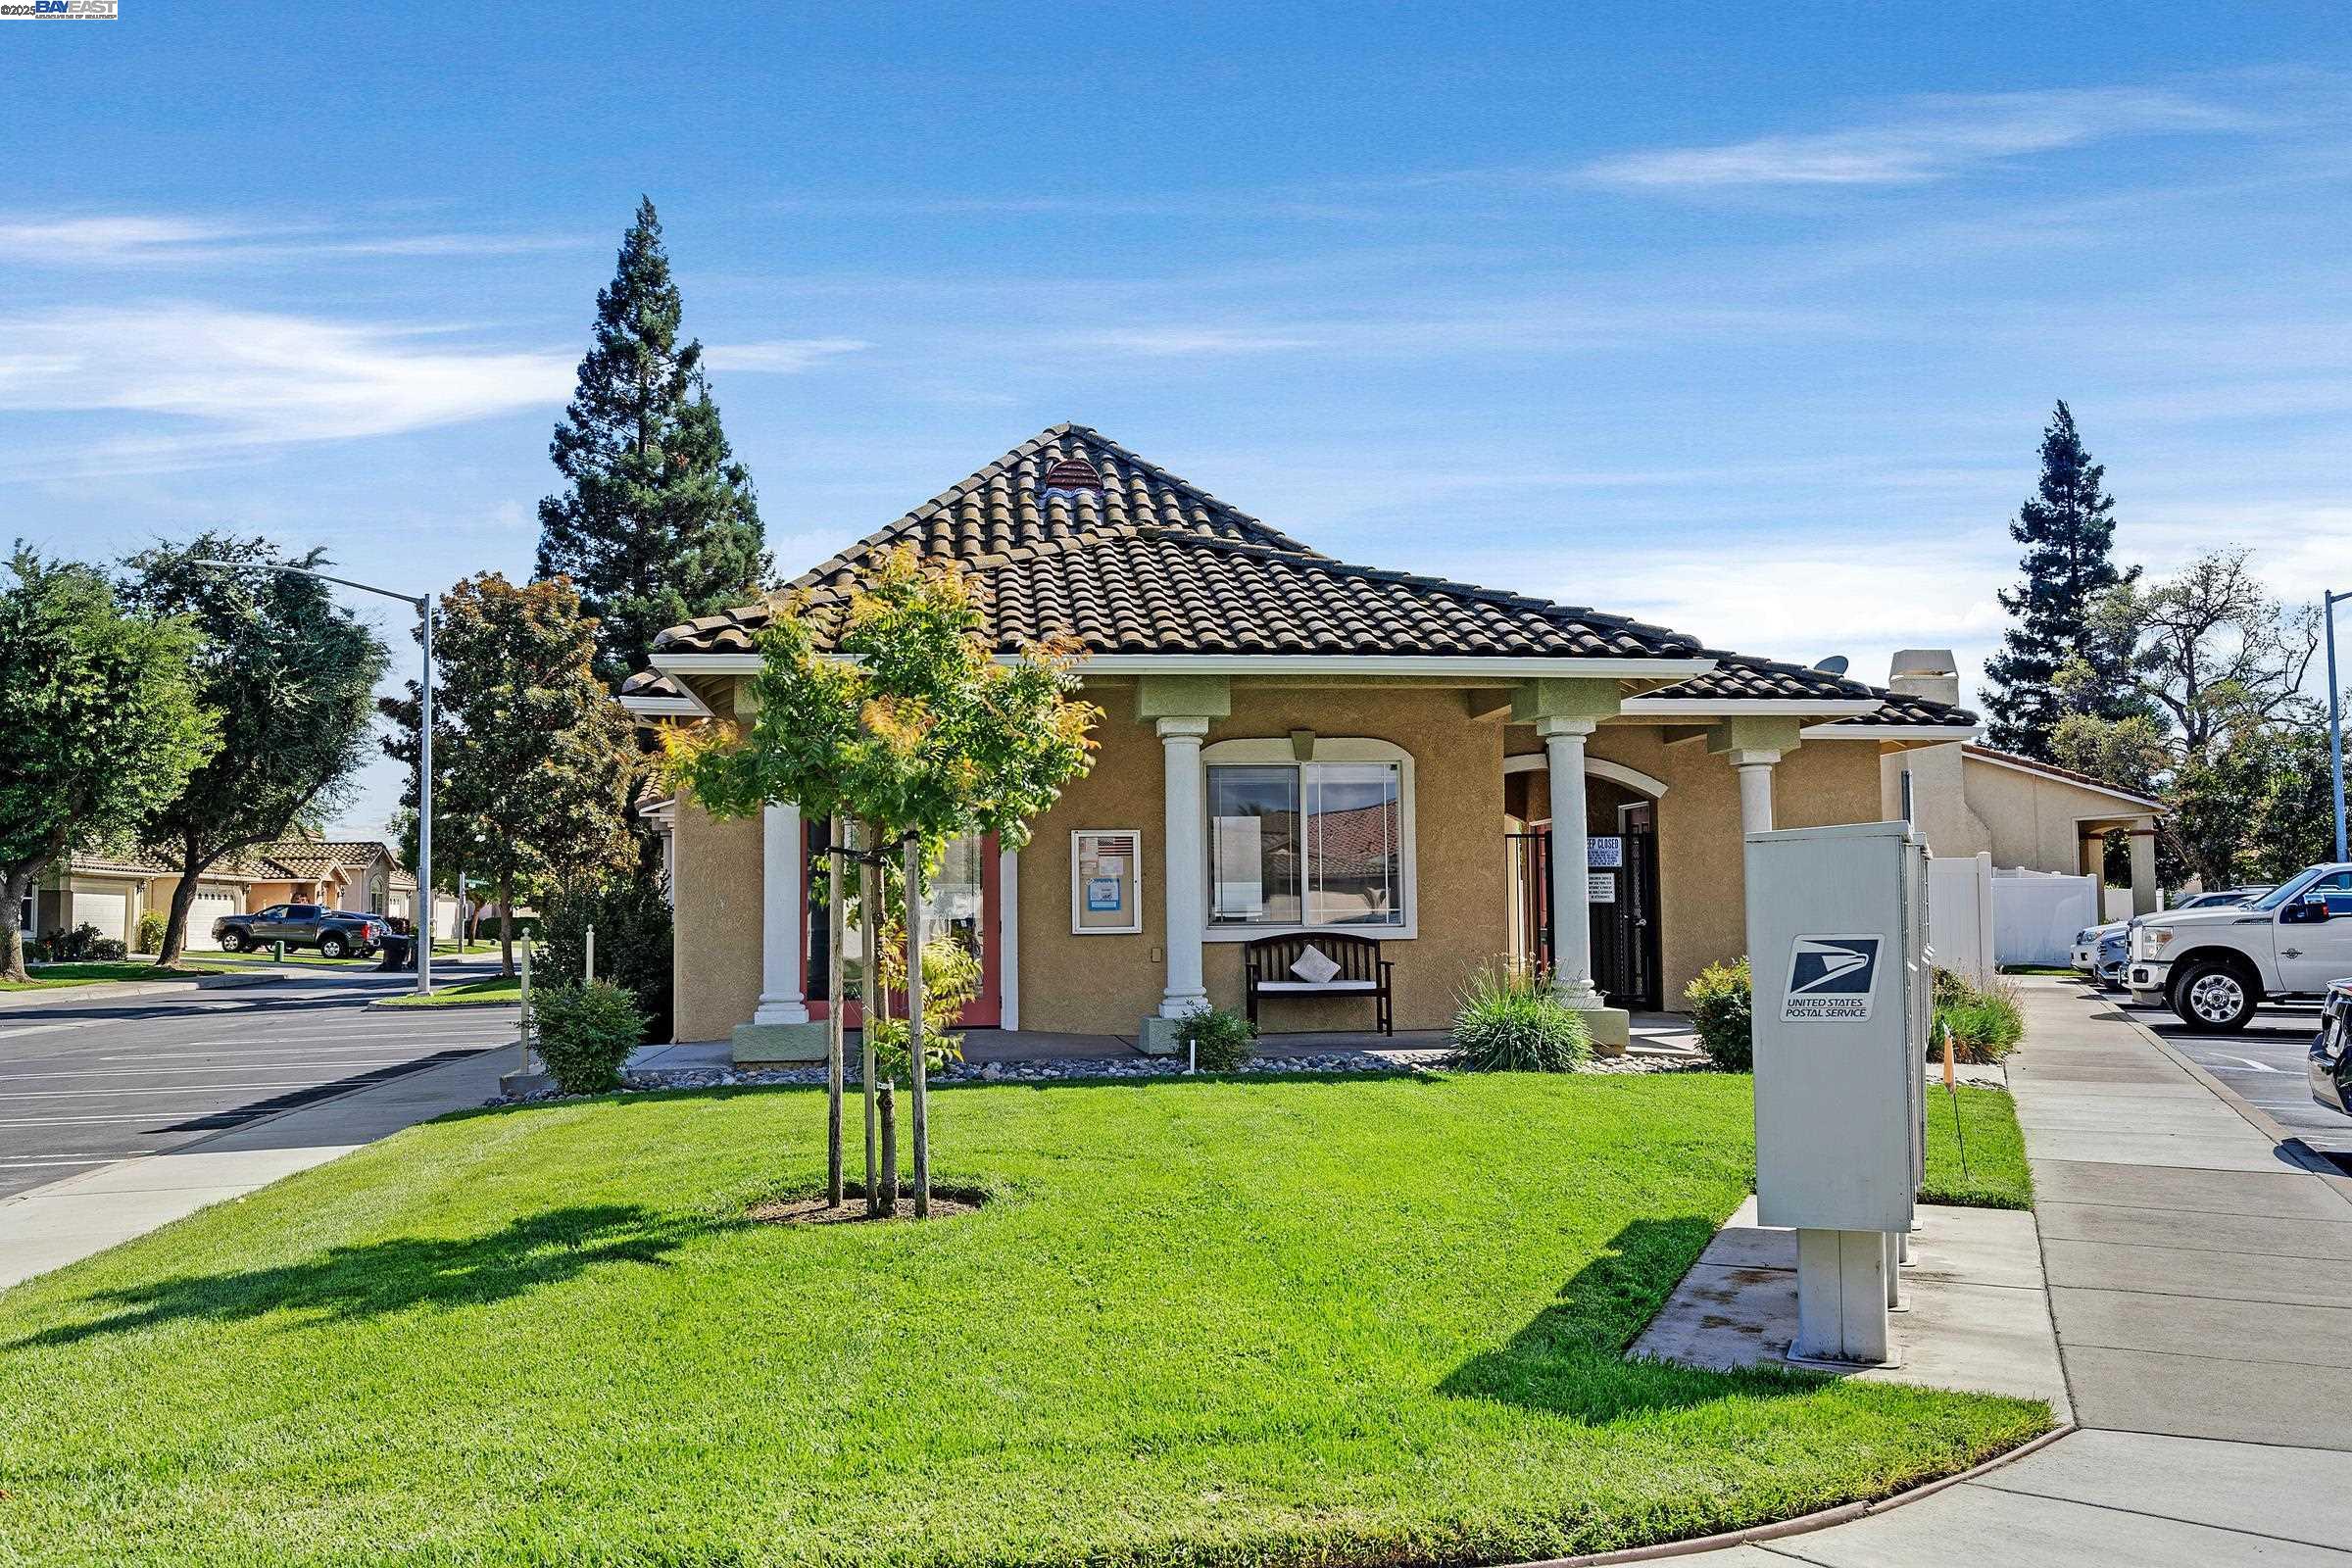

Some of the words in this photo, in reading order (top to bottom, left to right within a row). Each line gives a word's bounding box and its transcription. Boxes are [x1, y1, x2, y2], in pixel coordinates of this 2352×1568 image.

[1597, 838, 1619, 850] CLOSED
[1788, 999, 1827, 1007] UNITED
[1827, 999, 1864, 1007] STATES
[1786, 1008, 1823, 1017] POSTAL
[1825, 1008, 1867, 1017] SERVICE
